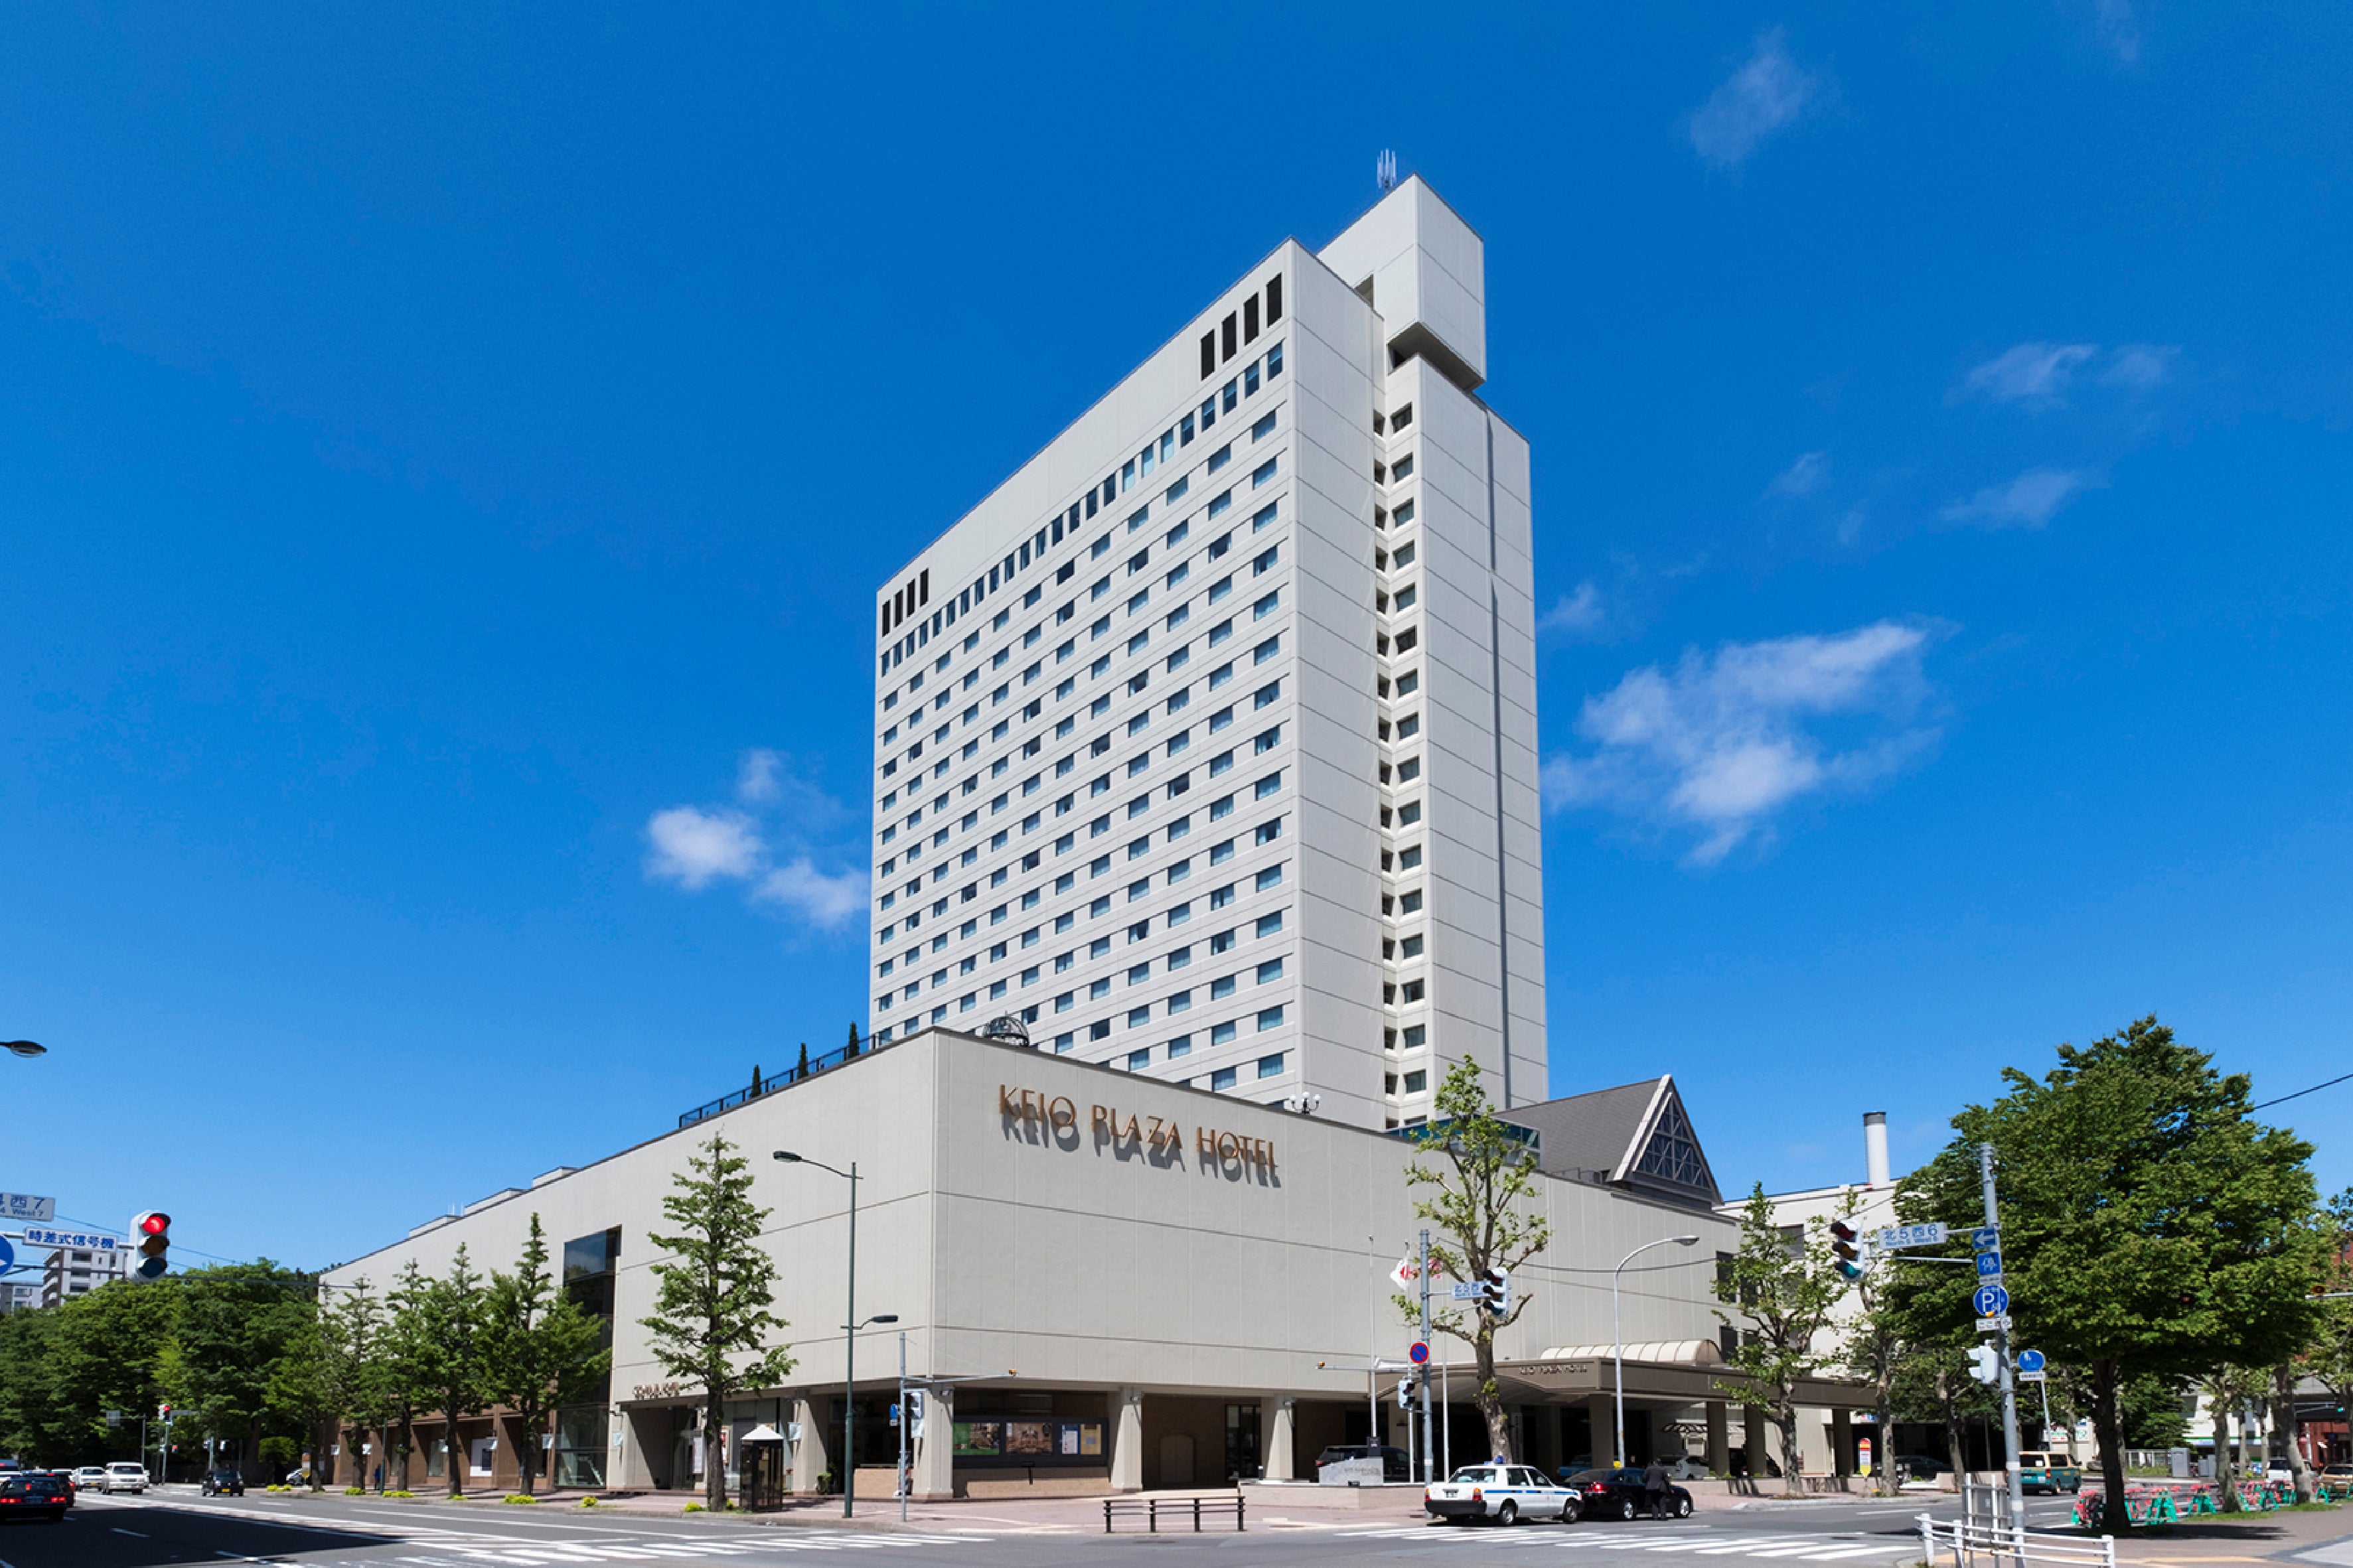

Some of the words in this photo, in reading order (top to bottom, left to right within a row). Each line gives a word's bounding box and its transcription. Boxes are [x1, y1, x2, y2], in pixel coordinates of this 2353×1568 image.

[999, 1084, 1077, 1127] KEIO
[1091, 1104, 1183, 1149] PLAZA
[1196, 1126, 1279, 1169] HOTEL
[0, 1194, 45, 1210] 西7
[29, 1230, 114, 1249] 時差式信号機
[1884, 1224, 1937, 1241] 北5西6
